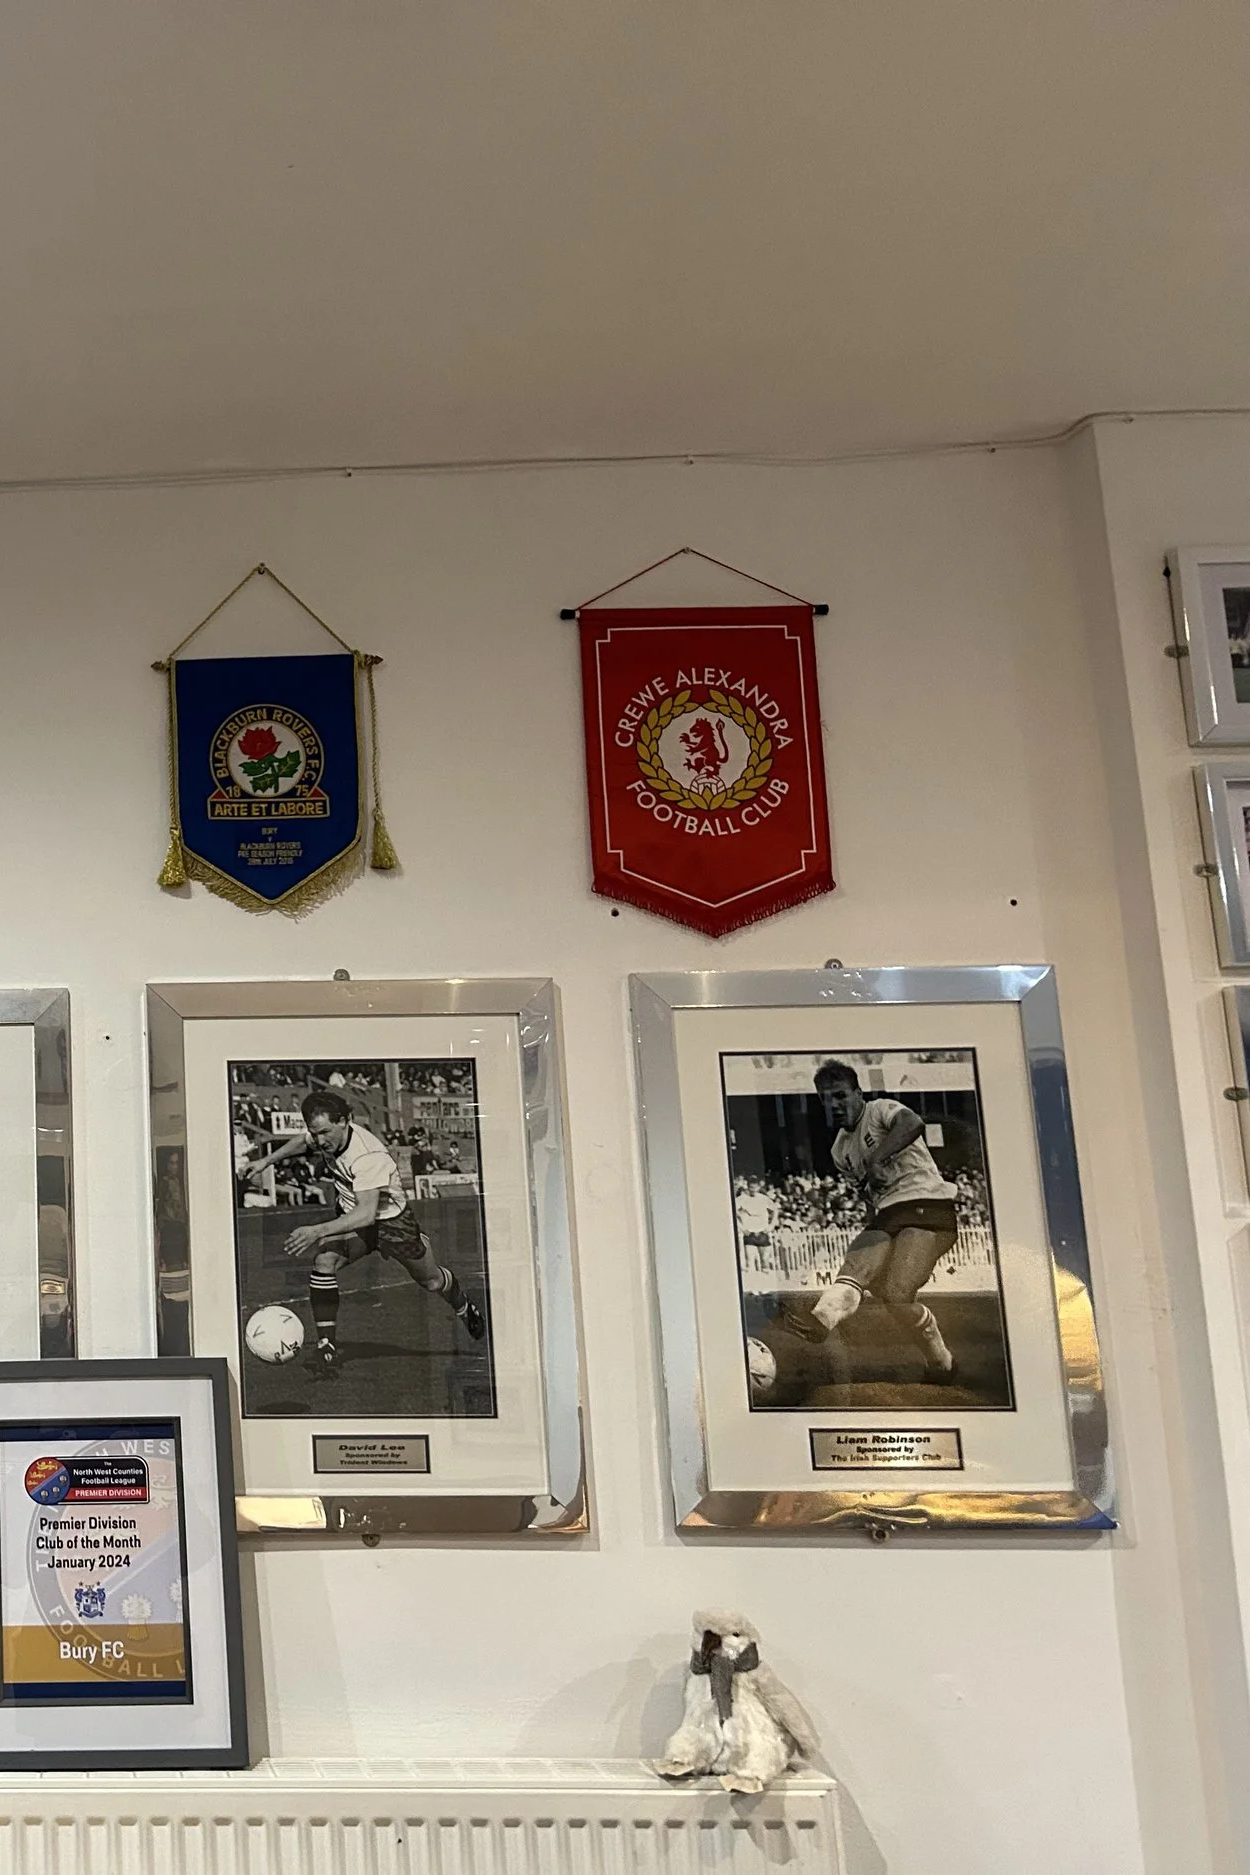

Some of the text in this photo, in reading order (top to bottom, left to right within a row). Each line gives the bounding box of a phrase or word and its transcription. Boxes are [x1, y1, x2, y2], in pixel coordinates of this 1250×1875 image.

[615, 667, 794, 750] CREWE ALEXANDRA
[214, 708, 268, 779] BLACKBURN
[272, 709, 319, 756] ROVERS
[226, 786, 241, 798] 18
[295, 784, 309, 797] 75
[214, 802, 324, 816] ARTE ET LABORE
[626, 778, 790, 836] FOOTBALL CLUB
[836, 1435, 931, 1445] Liam Robinson
[856, 1446, 914, 1454] Sponsored by
[830, 1454, 848, 1462] The
[872, 1454, 919, 1463] Supporters
[73, 1468, 144, 1476] North West Counties
[81, 1476, 136, 1485] Football League
[108, 1488, 142, 1496] DIVISION
[39, 1516, 136, 1530] Premier Division
[36, 1534, 142, 1550] Club of the Month
[47, 1554, 131, 1572] January 2024
[60, 1640, 124, 1664] Bury FC
